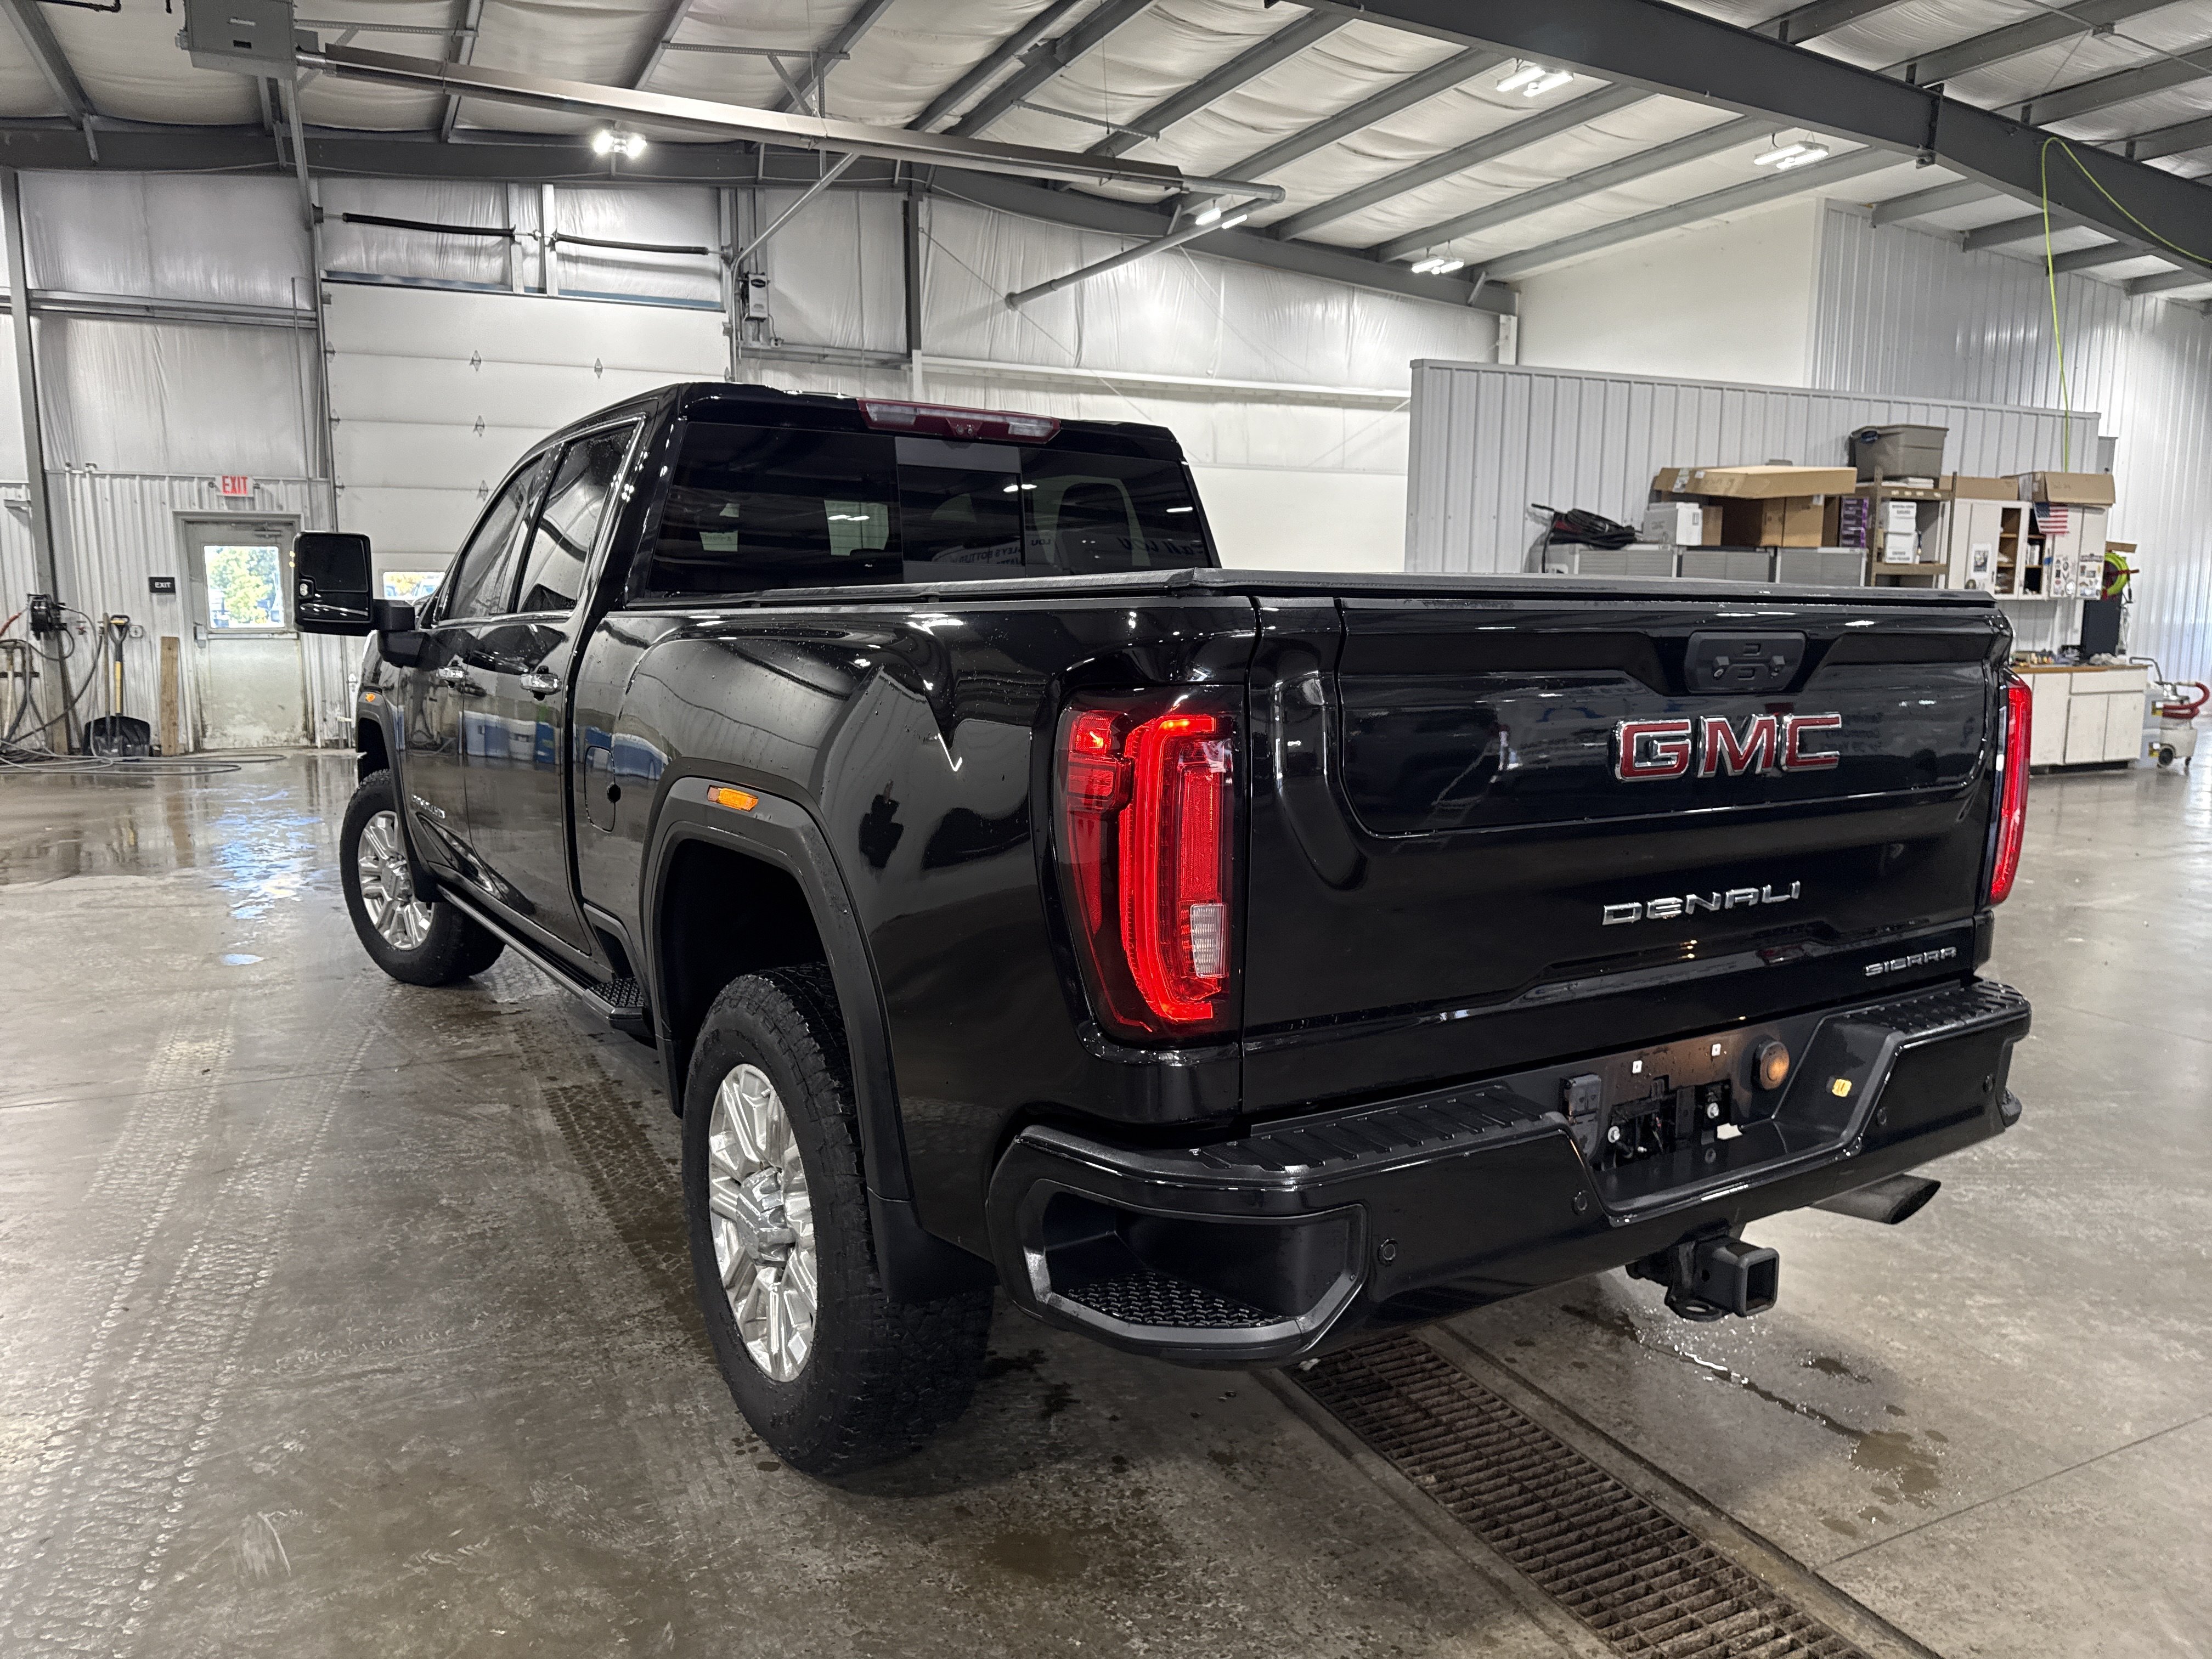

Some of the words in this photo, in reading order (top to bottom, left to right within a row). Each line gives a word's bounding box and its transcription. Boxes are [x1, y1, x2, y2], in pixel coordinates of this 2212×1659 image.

[222, 476, 248, 495] EXIT
[1616, 712, 1842, 783] GMC
[1602, 881, 1801, 926] DENALI
[1865, 946, 1957, 977] SIERRA
